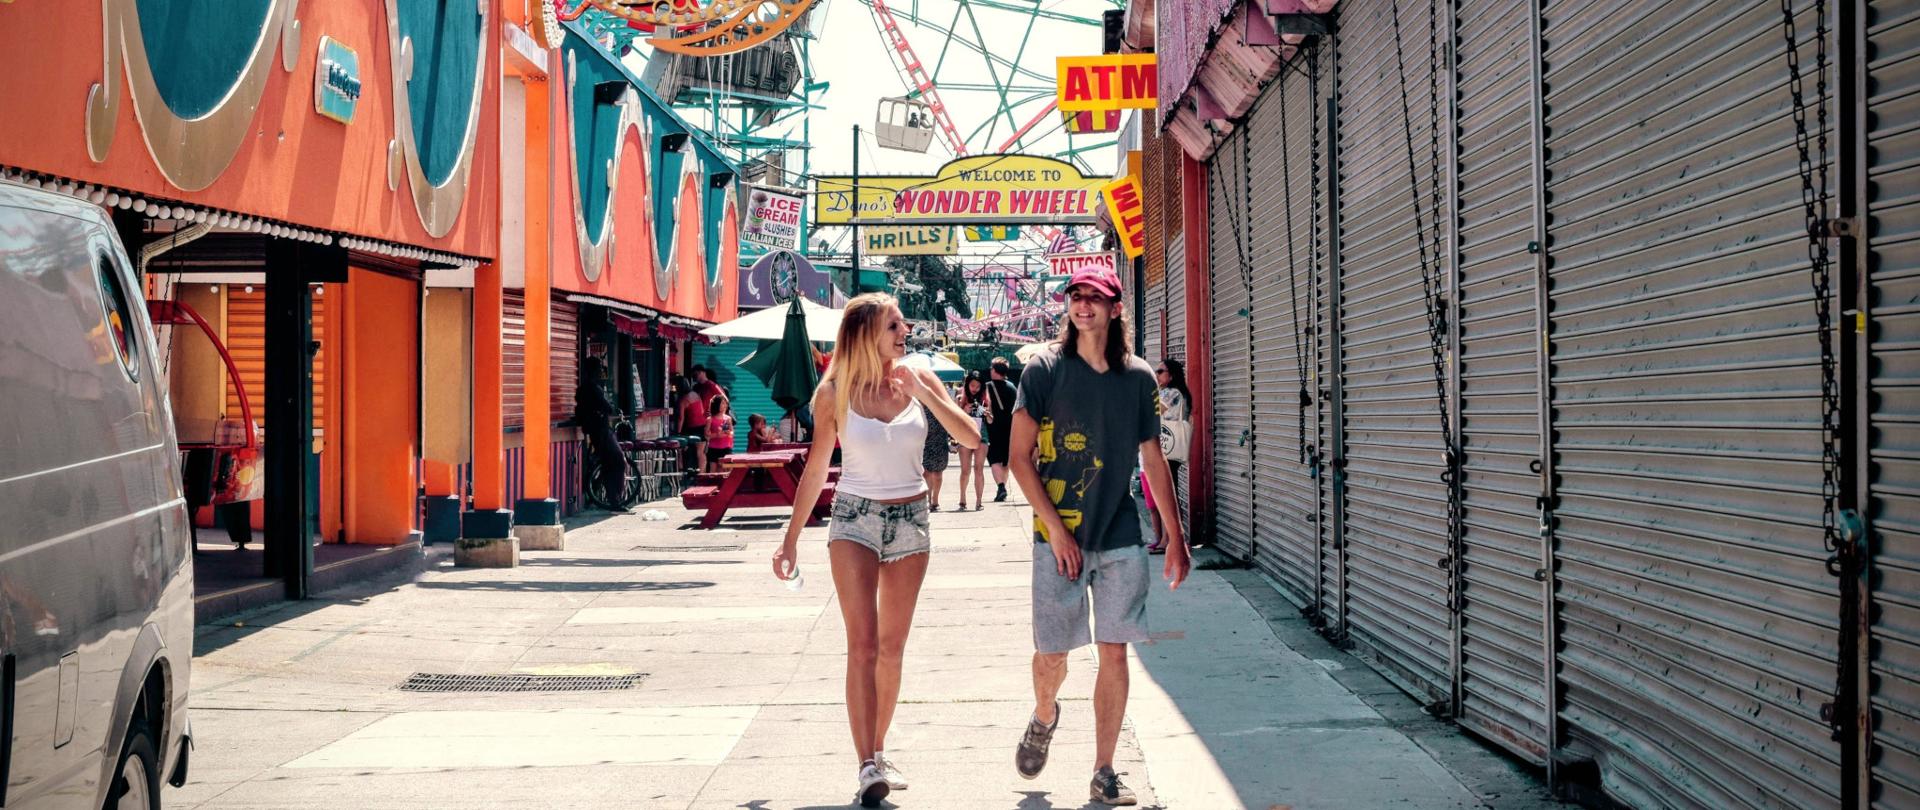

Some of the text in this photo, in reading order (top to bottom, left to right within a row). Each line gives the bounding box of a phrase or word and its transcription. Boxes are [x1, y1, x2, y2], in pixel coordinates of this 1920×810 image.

[1064, 64, 1158, 101] ATM
[959, 169, 1062, 182] WELCOME TO
[770, 197, 801, 213] ICE
[826, 191, 887, 212] Dno's
[895, 189, 1001, 214] WONDER
[1009, 189, 1089, 214] WHEEL
[755, 207, 799, 226] CREAM
[763, 222, 796, 237] SLUSHIES
[744, 231, 795, 250] ITALIAN ICES
[864, 227, 954, 252] HRILLS!
[1050, 254, 1114, 275] TATTOOS
